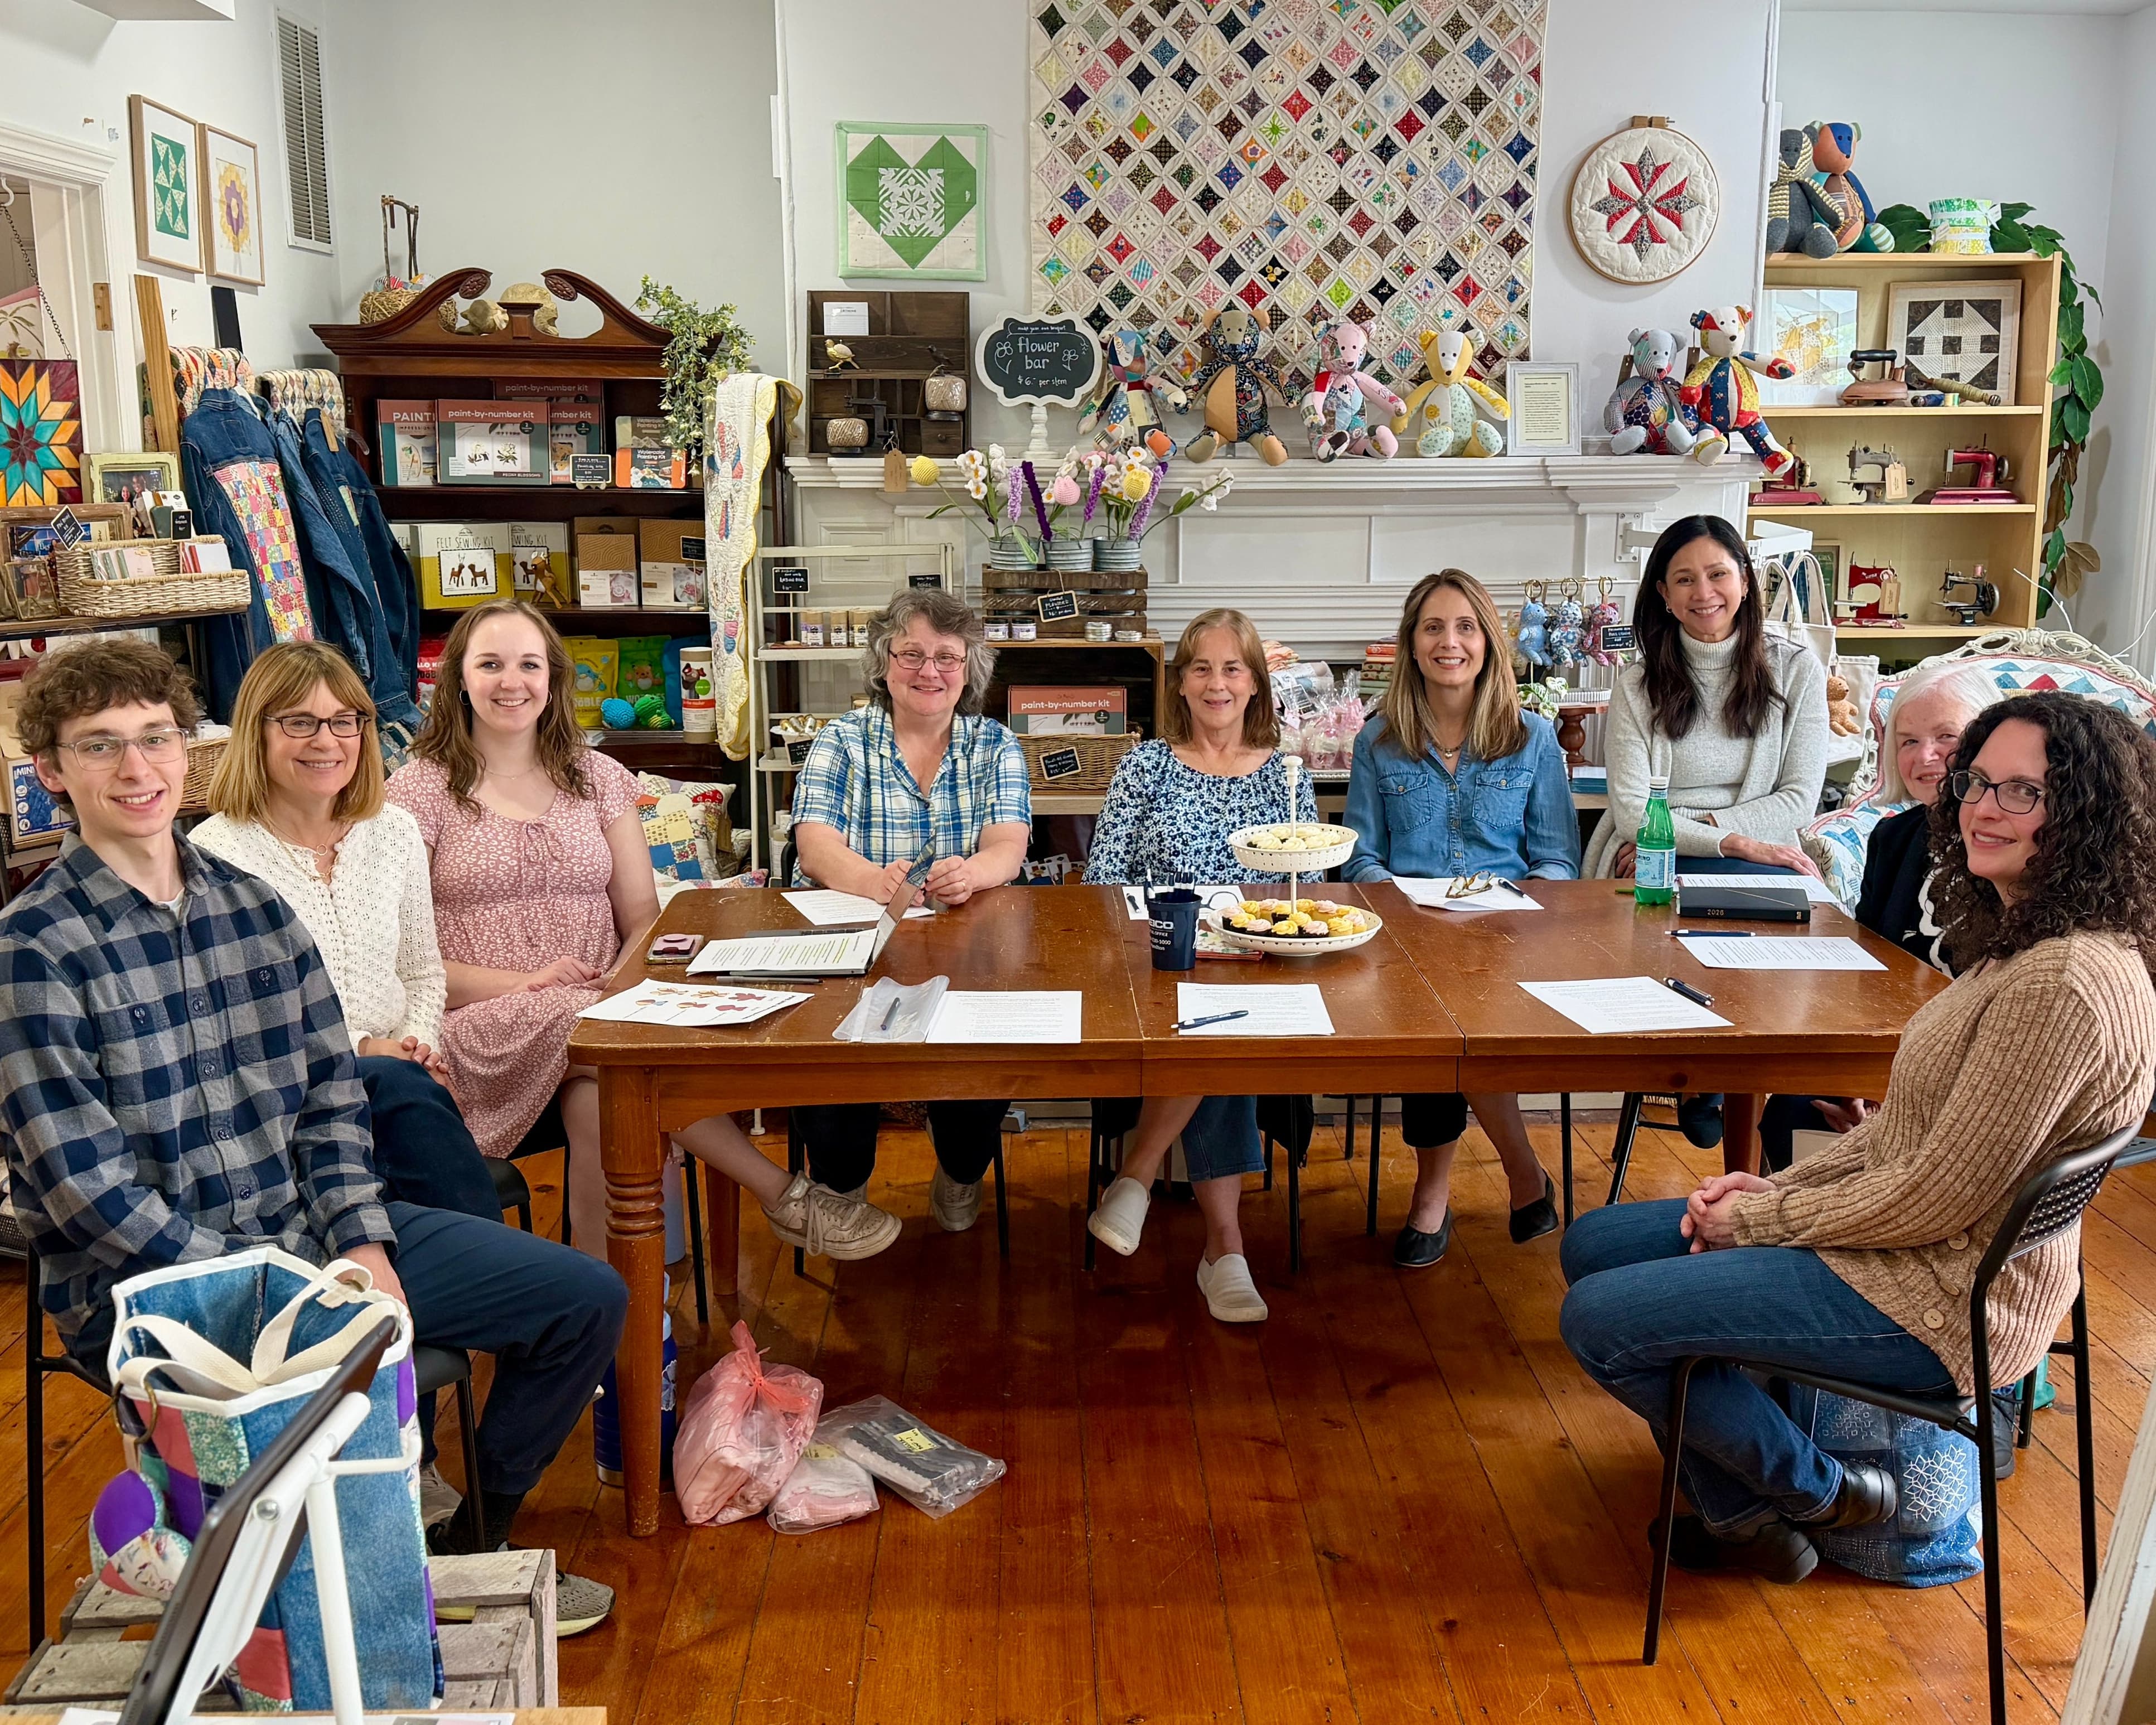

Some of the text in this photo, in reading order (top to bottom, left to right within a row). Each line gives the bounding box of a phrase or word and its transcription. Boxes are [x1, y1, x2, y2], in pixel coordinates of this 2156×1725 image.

[1017, 336, 1060, 353] flower
[1025, 355, 1050, 370] bar
[1038, 379, 1049, 388] per
[1051, 376, 1067, 386] stem
[505, 384, 576, 393] paint-by-number
[393, 412, 435, 422] PAINTI
[448, 409, 534, 419] paint-by-number kit
[579, 410, 592, 419] kit
[397, 536, 410, 547] FEL
[436, 535, 494, 548] FELT SEWING KIT
[536, 534, 548, 545] KIT
[1021, 699, 1110, 711] paint-by-number kit
[1148, 917, 1174, 930] EICO
